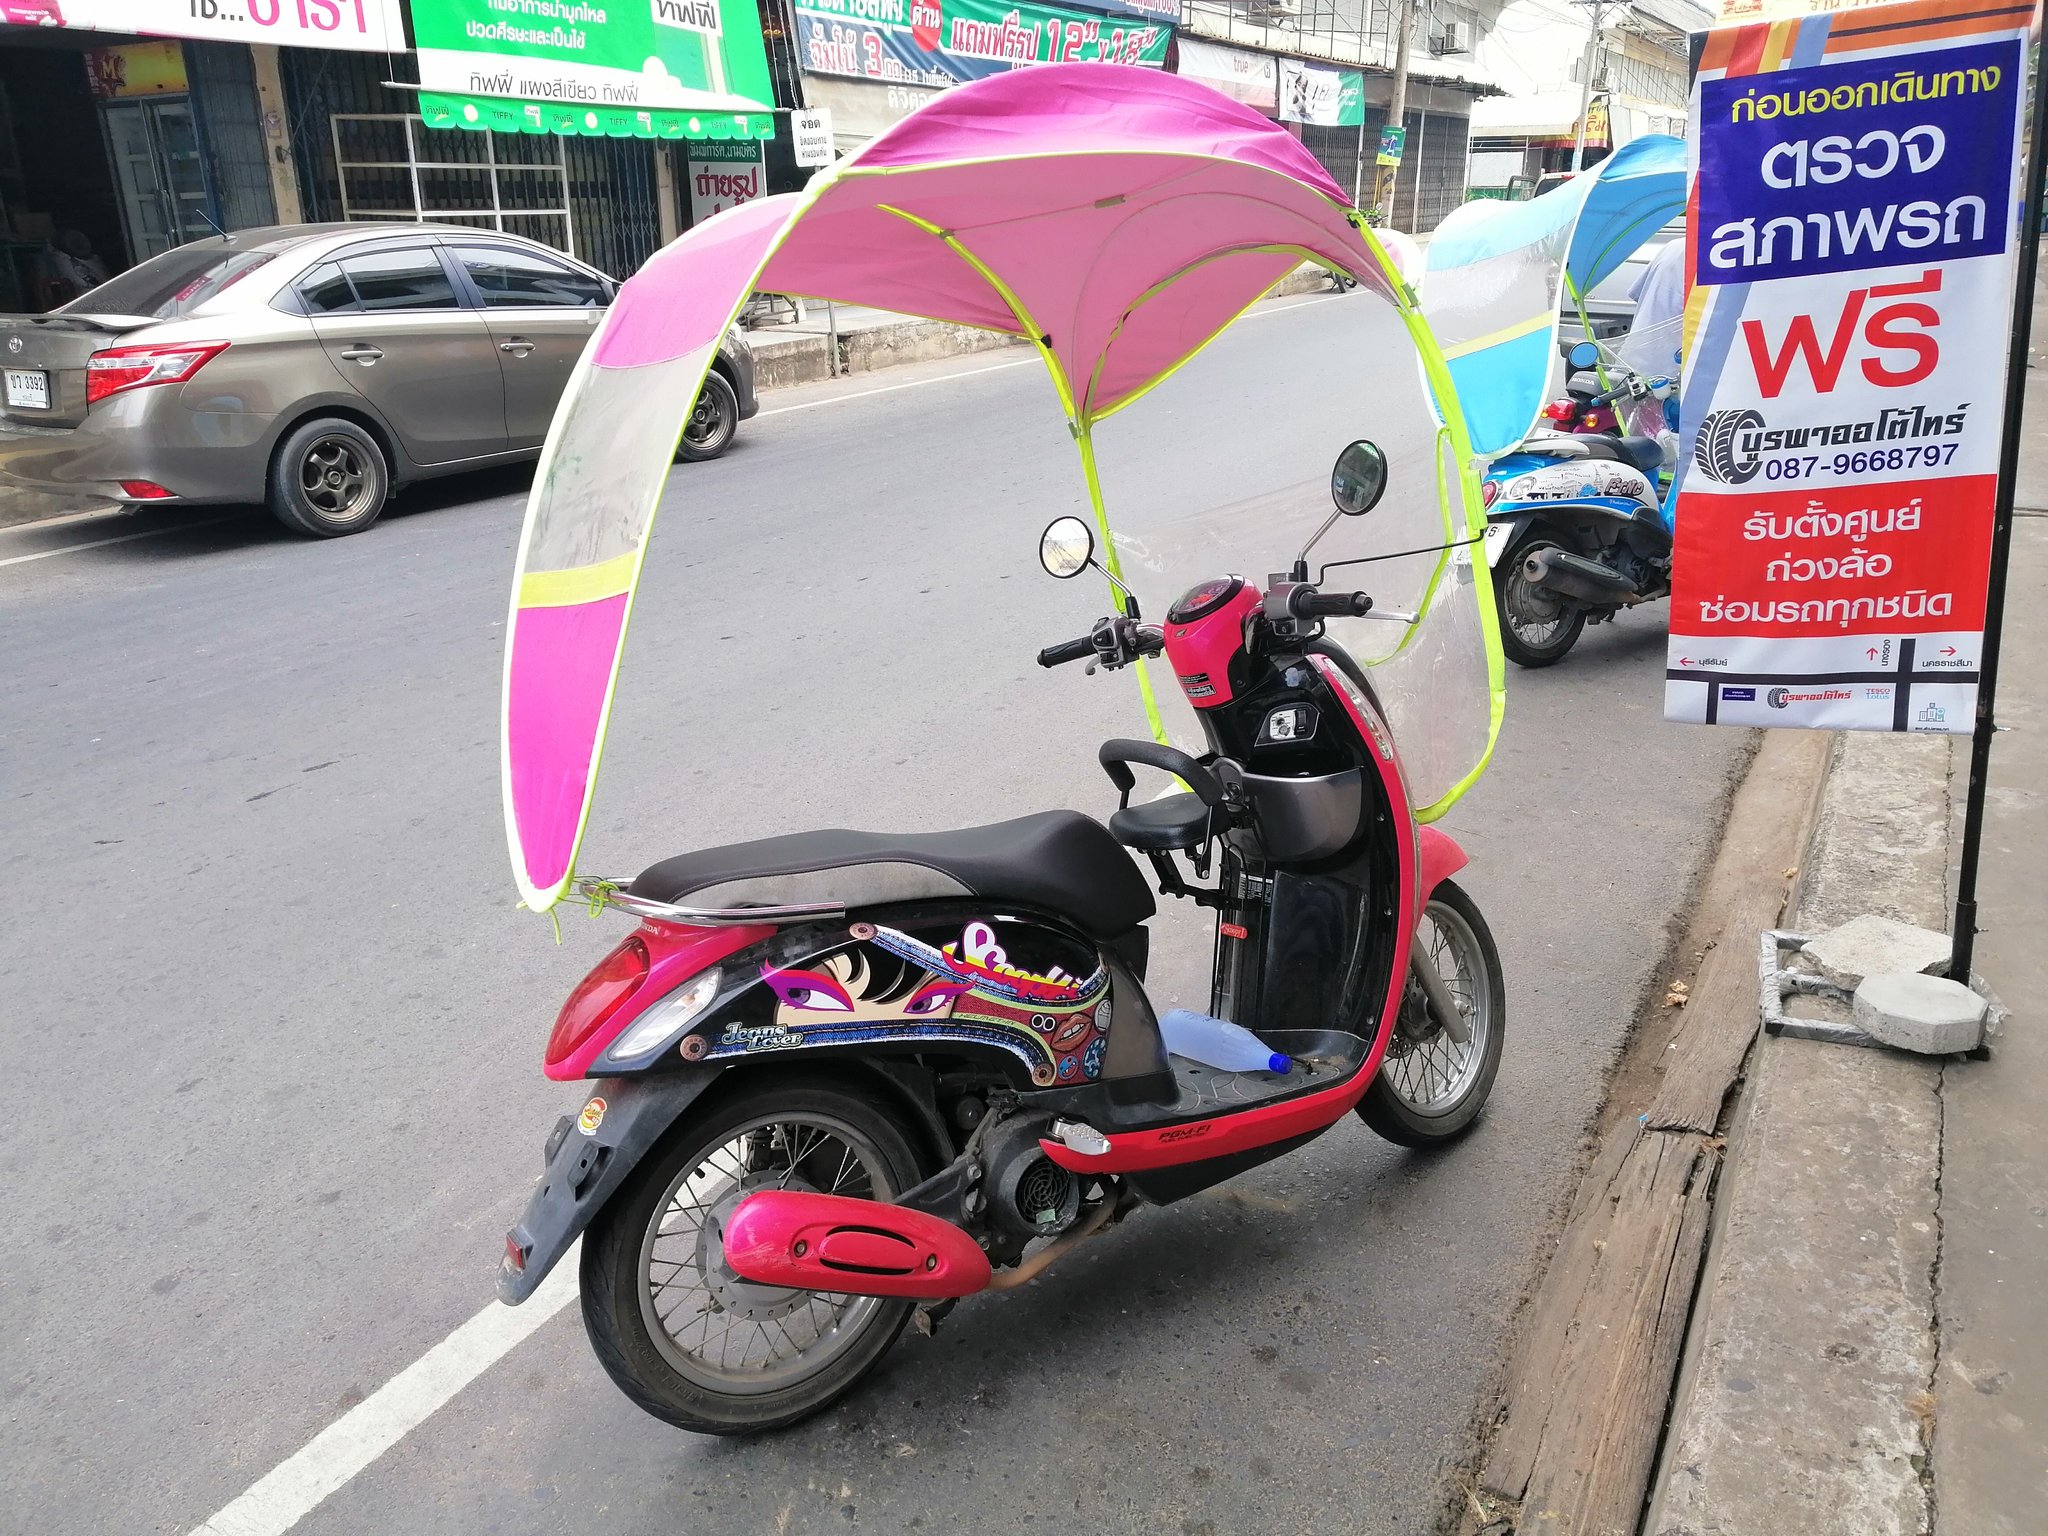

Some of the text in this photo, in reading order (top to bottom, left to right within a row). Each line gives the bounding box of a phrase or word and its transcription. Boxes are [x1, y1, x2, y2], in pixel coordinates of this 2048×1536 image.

[470, 72, 639, 103] ทิฟฟี่ แผงสีเขียว ทิฟฟี่
[1731, 65, 2001, 123] ก่อนออกเดินทาง
[493, 110, 514, 120] TIFFY
[609, 117, 628, 126] TIFFY
[1761, 124, 1946, 189] ตรวจ
[1709, 195, 1986, 269] สภาพรถ
[1742, 268, 1943, 398] ฟรี
[24, 375, 44, 391] 3392
[1571, 377, 1595, 386] HONDA
[1765, 443, 1959, 481] 087-9668797
[1743, 498, 1922, 543] รับตั้งศูนย์
[1766, 547, 1893, 582] ถ่วงล้อ
[1700, 589, 1953, 628] ซ่อมรถทุกชนิด
[721, 1022, 789, 1045] Jeans
[746, 1033, 804, 1051] Lover
[1158, 1124, 1212, 1141] PGM-FI
